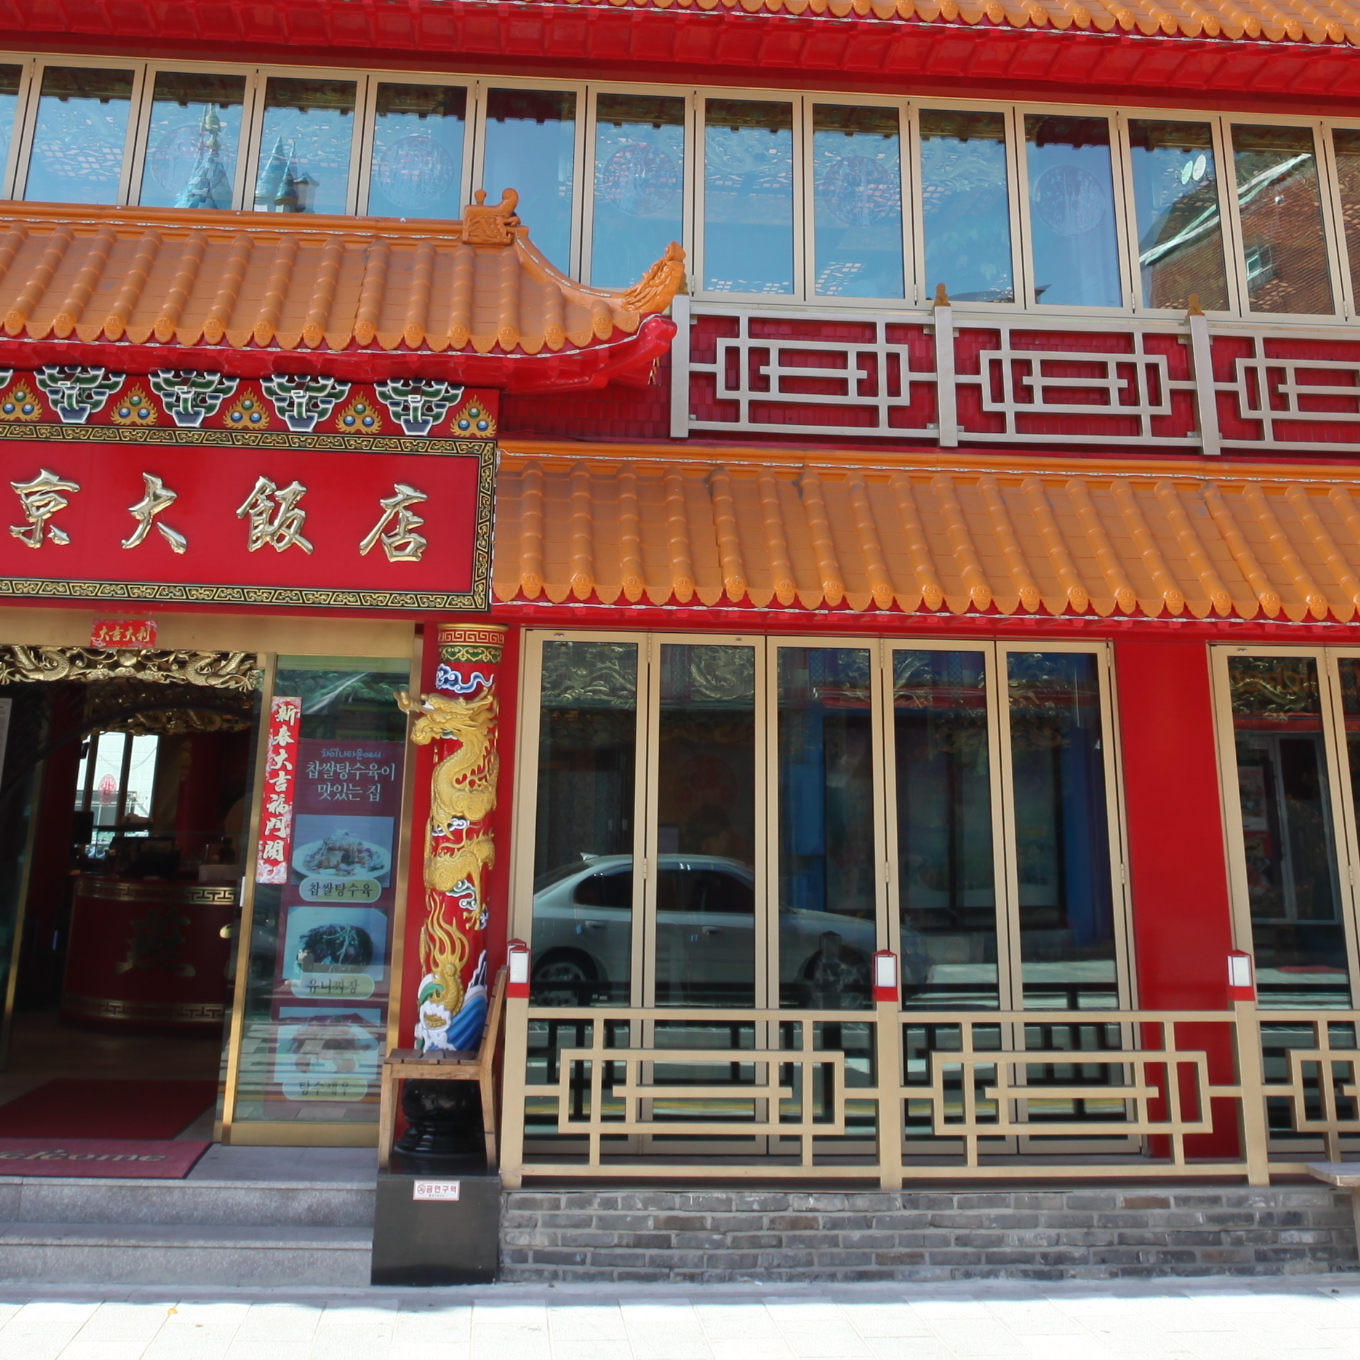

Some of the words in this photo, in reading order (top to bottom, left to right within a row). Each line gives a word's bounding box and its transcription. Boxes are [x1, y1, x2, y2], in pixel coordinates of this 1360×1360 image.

[305, 760, 396, 781] 찹쌀탕수육이
[317, 782, 363, 801] 맛있는
[366, 783, 381, 802] 집
[308, 881, 373, 898] 찹쌀탕수육
[307, 979, 360, 994] 유니짜장
